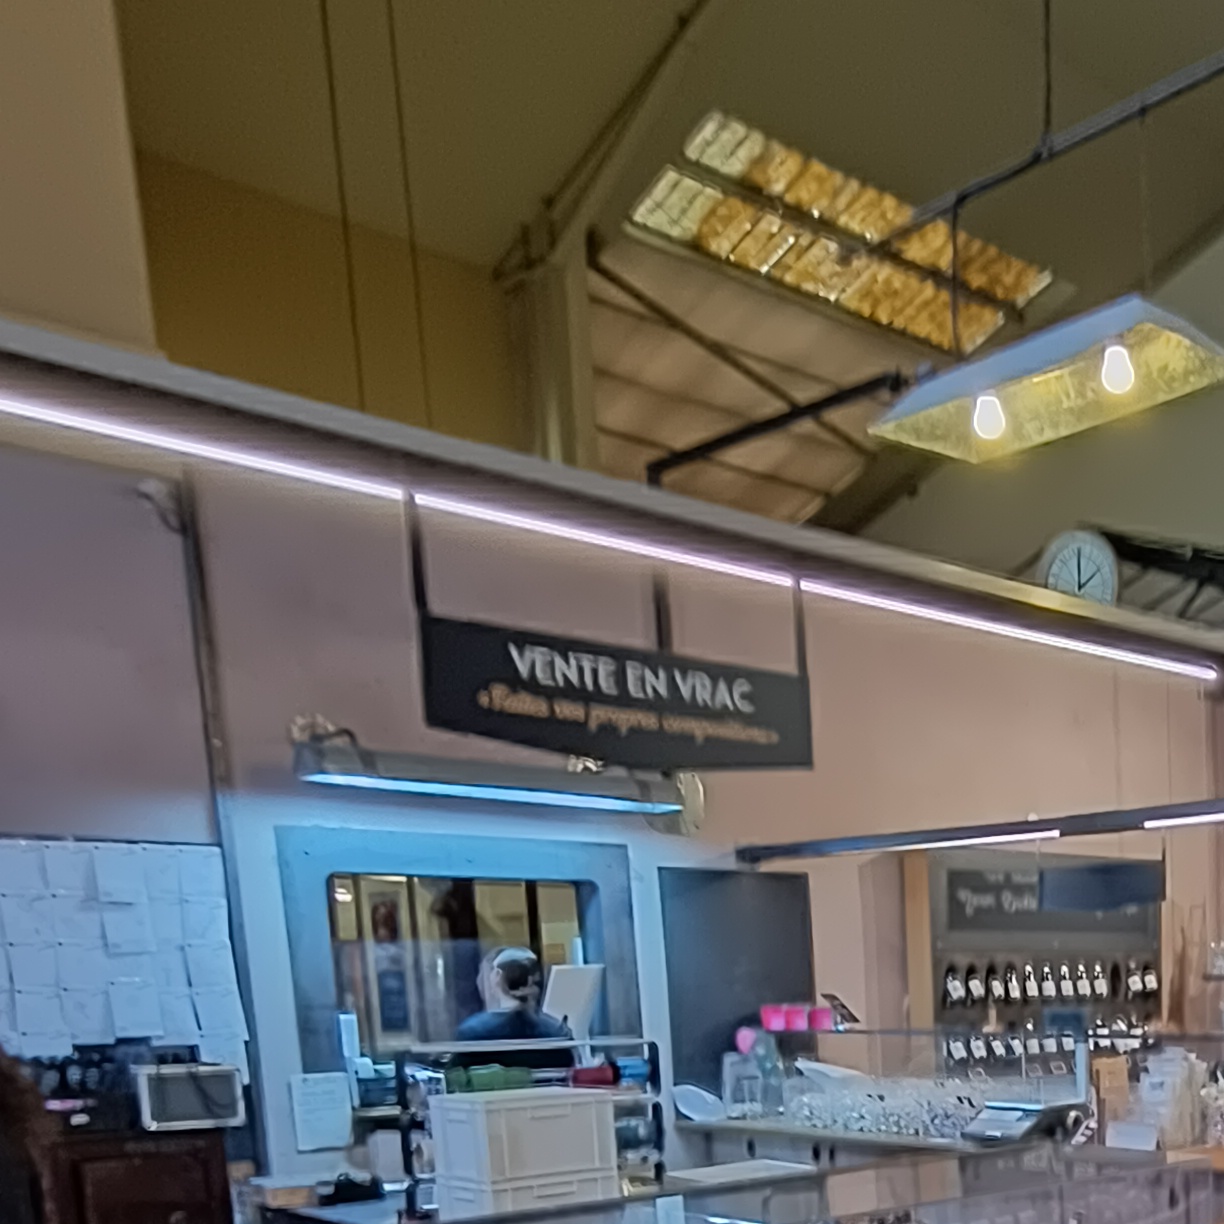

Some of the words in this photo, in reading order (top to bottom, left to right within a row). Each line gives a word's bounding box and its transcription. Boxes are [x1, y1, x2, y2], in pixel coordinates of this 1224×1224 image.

[508, 641, 619, 697] VENTE
[626, 659, 668, 700] EN
[673, 667, 756, 715] VRAC
